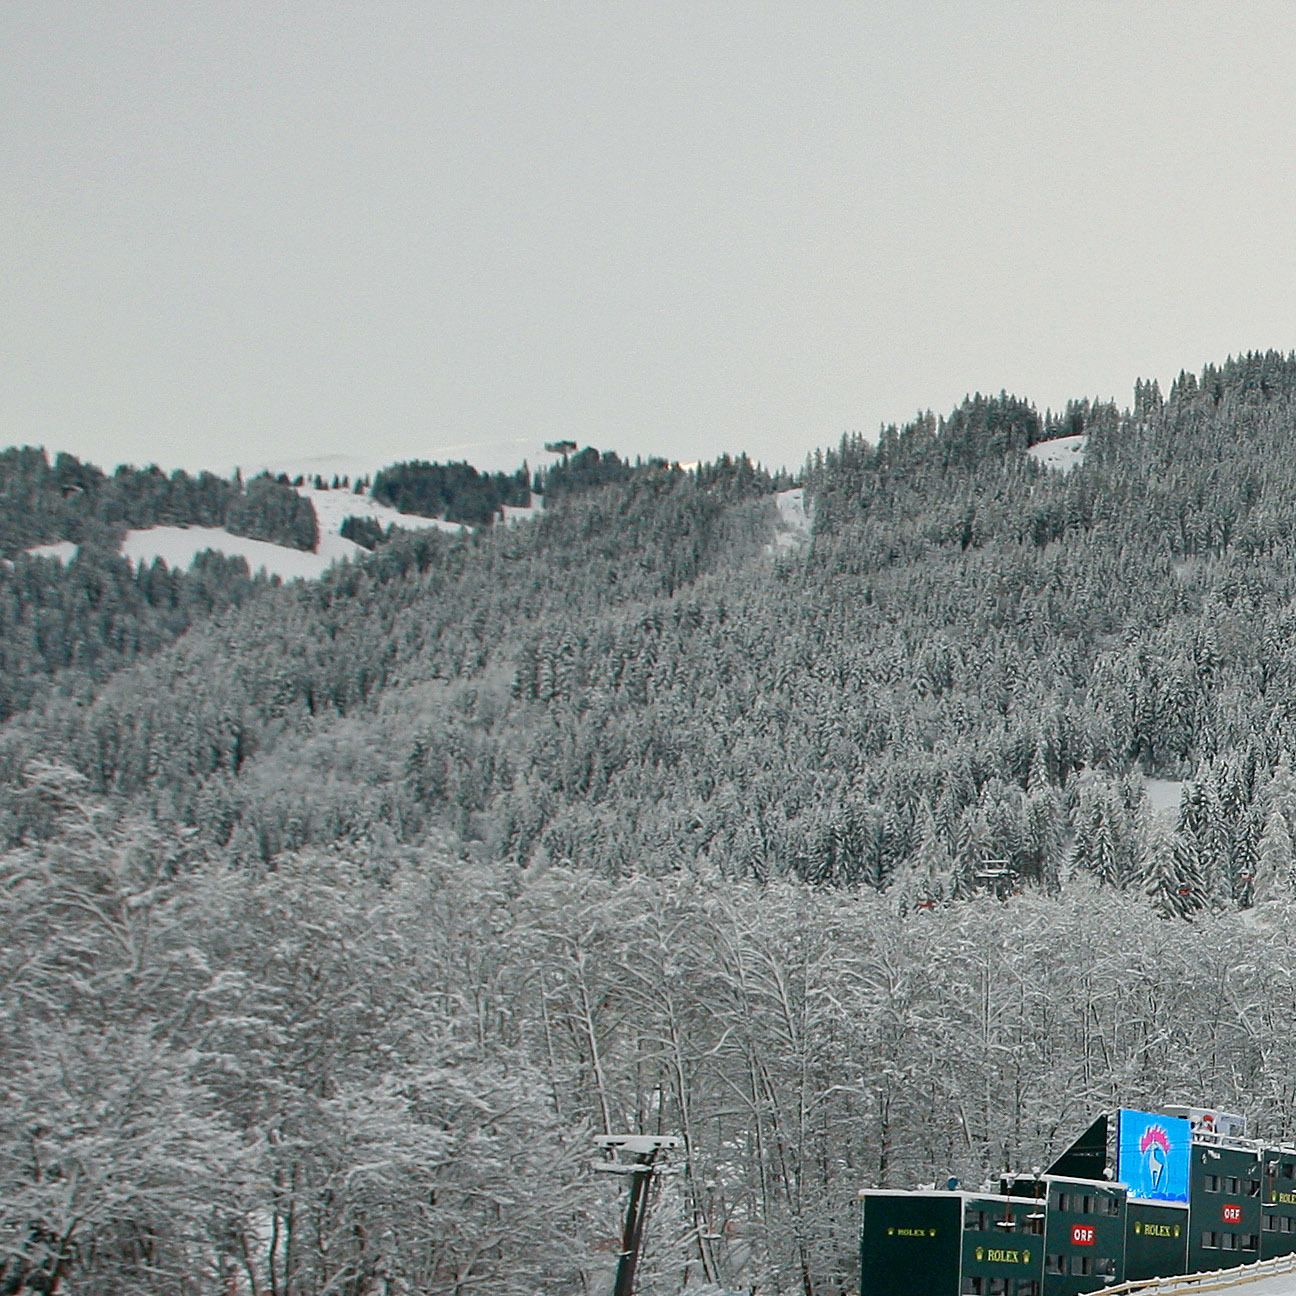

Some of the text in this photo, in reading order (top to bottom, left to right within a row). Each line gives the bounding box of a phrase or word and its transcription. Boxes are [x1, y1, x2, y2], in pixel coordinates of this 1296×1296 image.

[1224, 1208, 1240, 1219] ORF
[1074, 1230, 1093, 1241] ORF
[1144, 1224, 1171, 1237] ROLEX
[988, 1249, 1019, 1263] ROLEX
